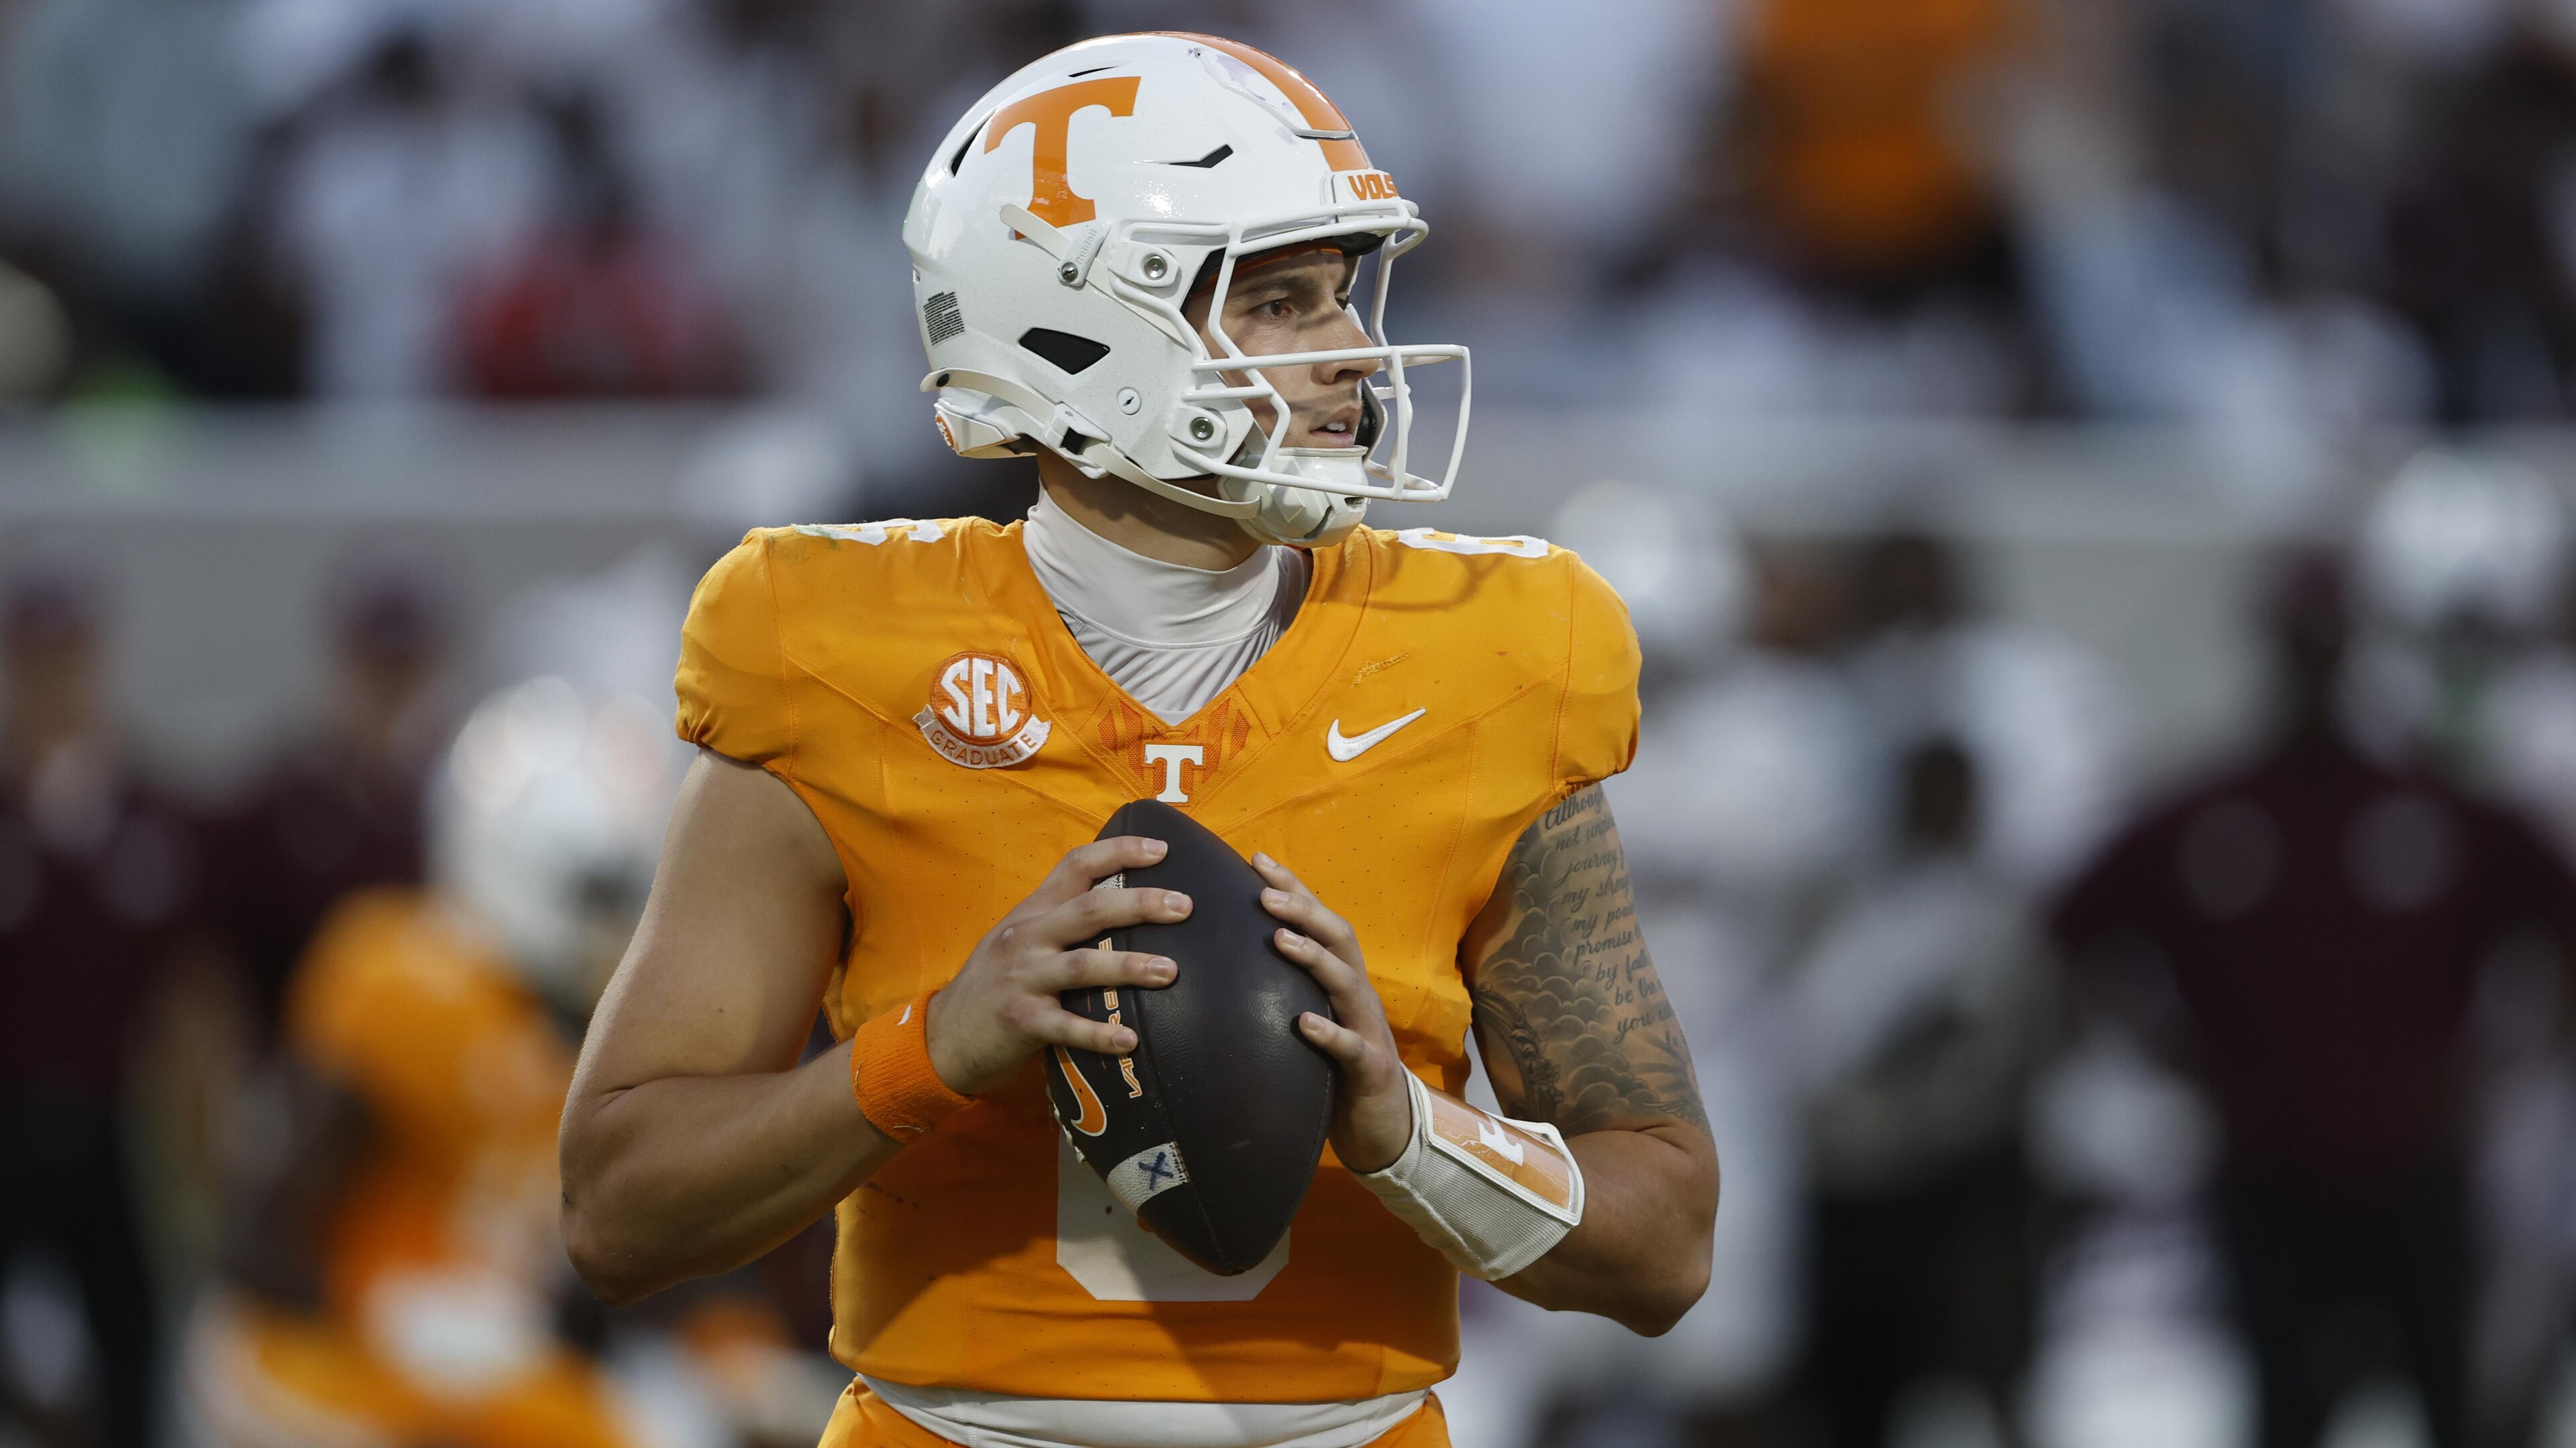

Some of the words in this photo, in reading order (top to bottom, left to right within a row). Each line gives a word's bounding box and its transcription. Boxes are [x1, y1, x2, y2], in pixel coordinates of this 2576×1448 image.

[983, 75, 1142, 241] T
[1347, 173, 1399, 201] VOLS
[939, 657, 1022, 737] SEC
[928, 728, 1038, 765] GRADUATE
[1144, 743, 1204, 803] T
